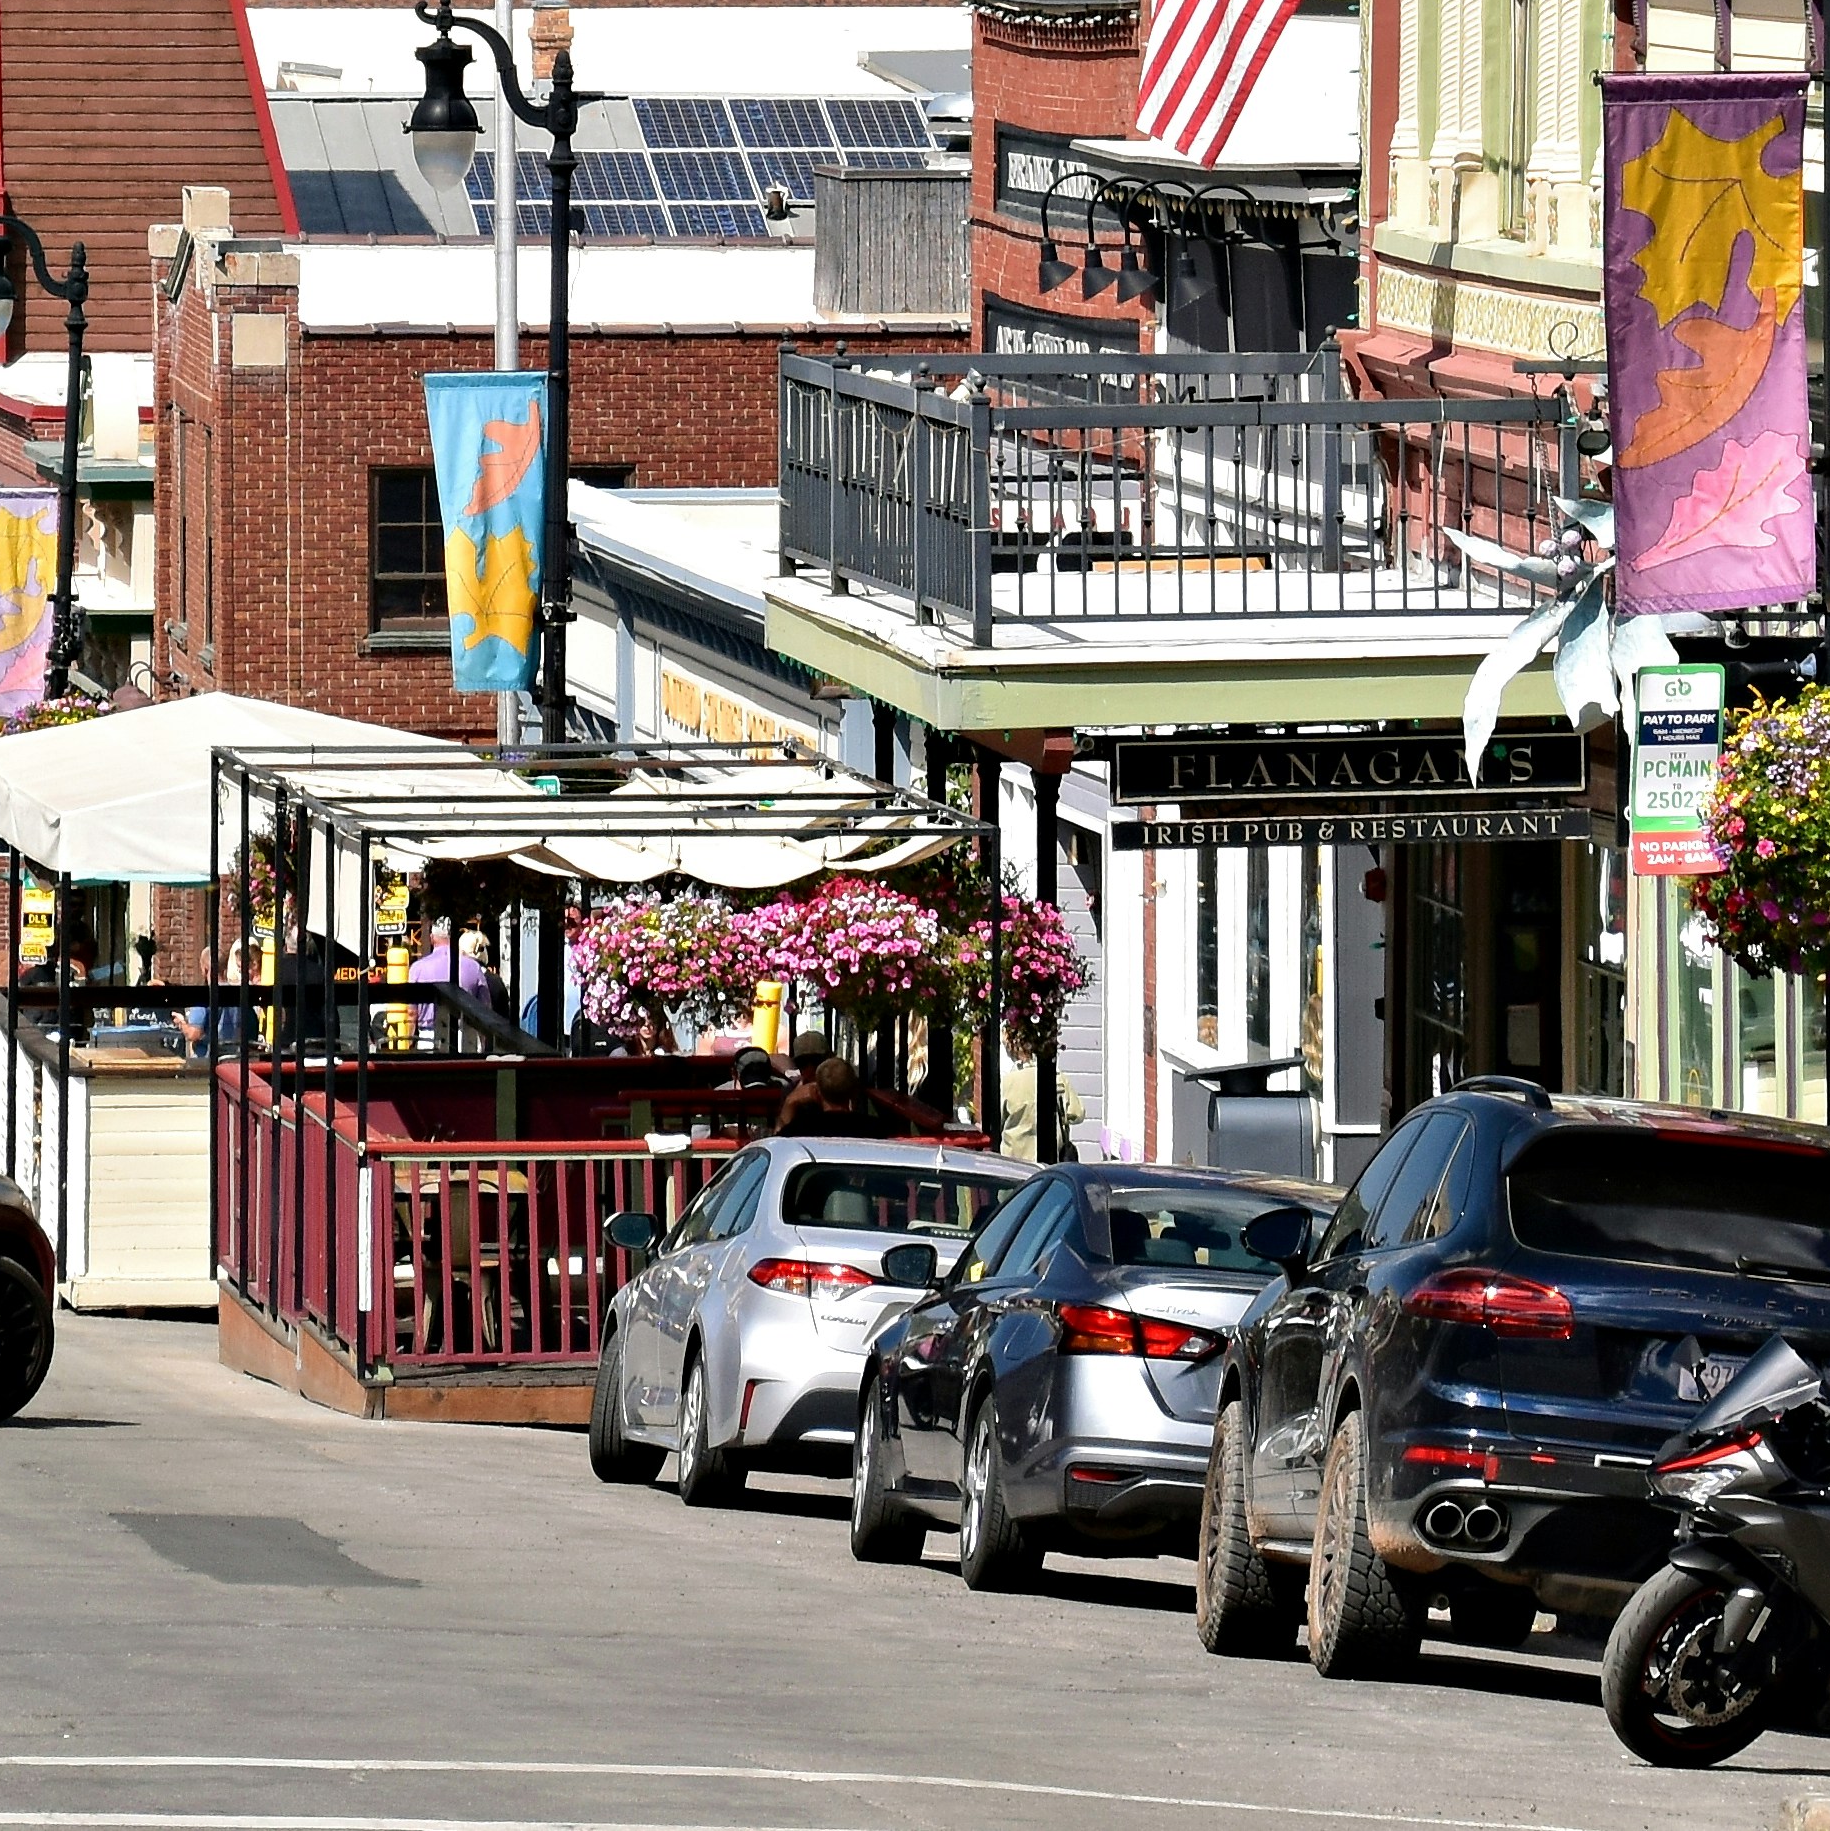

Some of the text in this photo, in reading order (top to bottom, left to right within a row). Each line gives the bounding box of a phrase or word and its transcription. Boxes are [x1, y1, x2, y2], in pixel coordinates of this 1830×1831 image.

[1642, 713, 1717, 726] PAY TO PARK
[1643, 760, 1712, 778] PCMAIN
[1672, 782, 1682, 790] TO
[1142, 814, 1564, 846] IRISH PUB & RESTAURANT
[1639, 840, 1710, 852] NO PARKIN
[1647, 853, 1675, 865] 2AM
[28, 913, 48, 925] DLS
